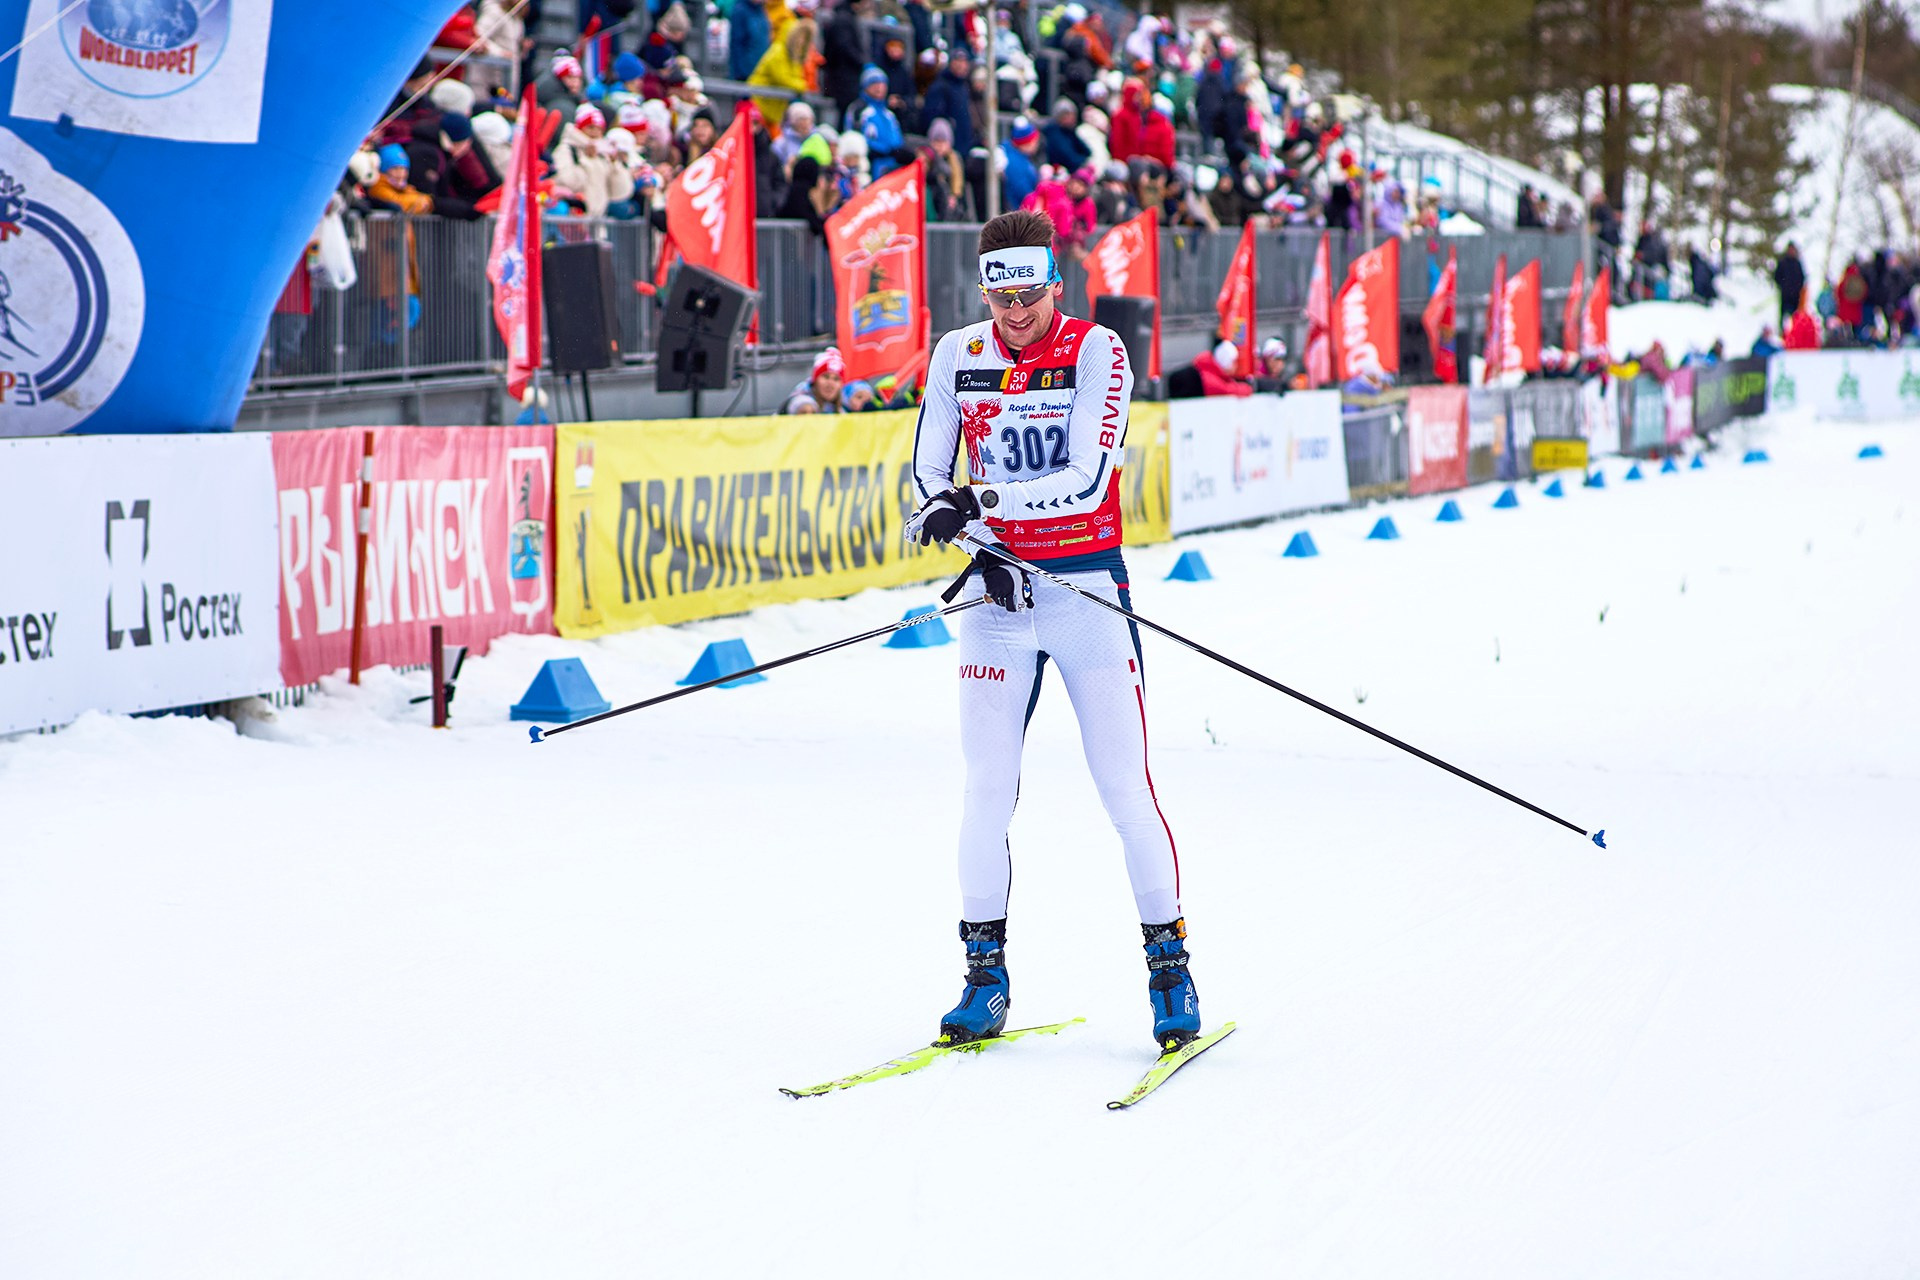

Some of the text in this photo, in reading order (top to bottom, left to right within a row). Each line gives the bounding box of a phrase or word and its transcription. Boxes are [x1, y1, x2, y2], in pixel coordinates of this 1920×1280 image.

[80, 25, 199, 76] WORLDLOPPET
[998, 267, 1035, 281] ILVES
[1013, 372, 1027, 383] 50
[1009, 383, 1023, 391] KM
[1099, 347, 1124, 449] BIVIUM
[1008, 402, 1071, 412] Rostec Demino
[1029, 411, 1064, 419] marathon
[1001, 425, 1070, 473] 302
[617, 462, 886, 604] ПРАВИТЕЛЬСТВО
[161, 583, 243, 643] Ростех
[967, 957, 996, 967] PINE
[1150, 957, 1187, 969] SPINE
[1184, 982, 1193, 1015] SPINE
